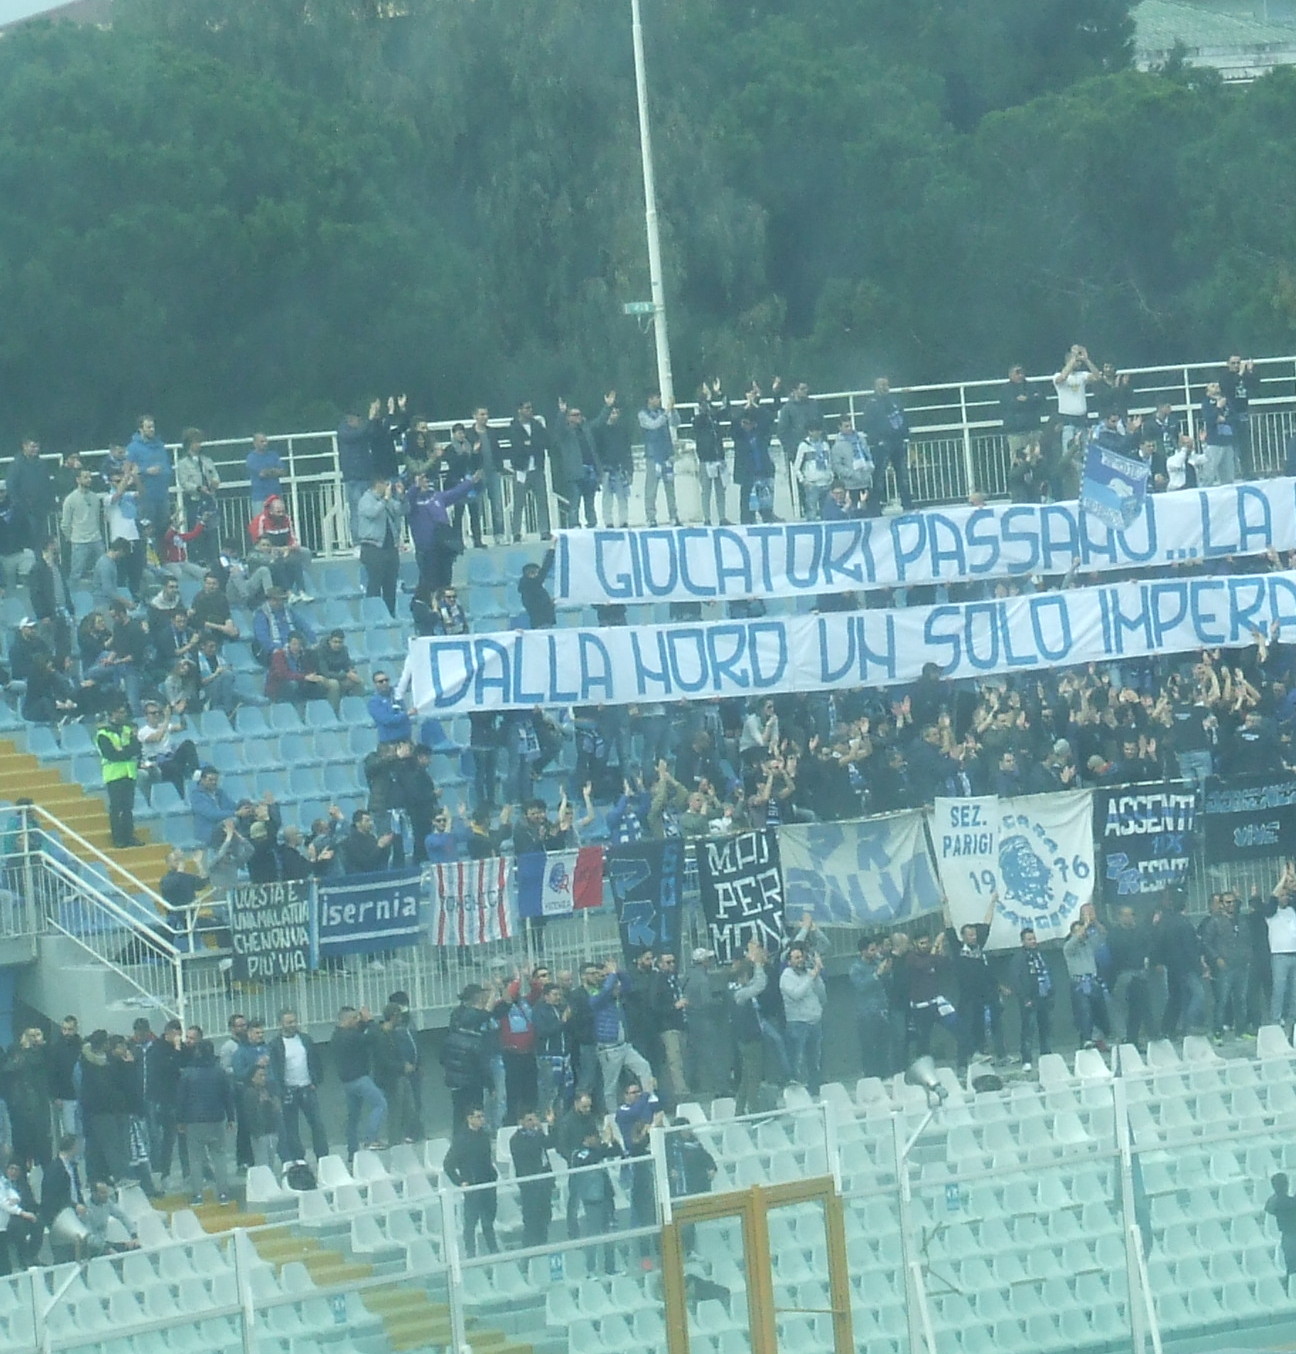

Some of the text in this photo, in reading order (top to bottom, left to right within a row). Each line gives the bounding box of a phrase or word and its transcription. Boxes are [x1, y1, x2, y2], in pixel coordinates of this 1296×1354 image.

[560, 533, 569, 598] I
[594, 521, 876, 598] GIOCATORI
[429, 632, 613, 707] DALLA
[631, 621, 788, 695] NORD
[924, 594, 1072, 675] SOLO
[951, 805, 987, 828] SEZ.
[1105, 794, 1195, 836] ASSENTI
[943, 833, 993, 858] PARIGI
[713, 867, 782, 919] PER
[969, 854, 1090, 895] 19 76
[321, 891, 417, 927] isernia
[233, 926, 310, 954] CHE NON VA
[278, 950, 306, 973] VIA
